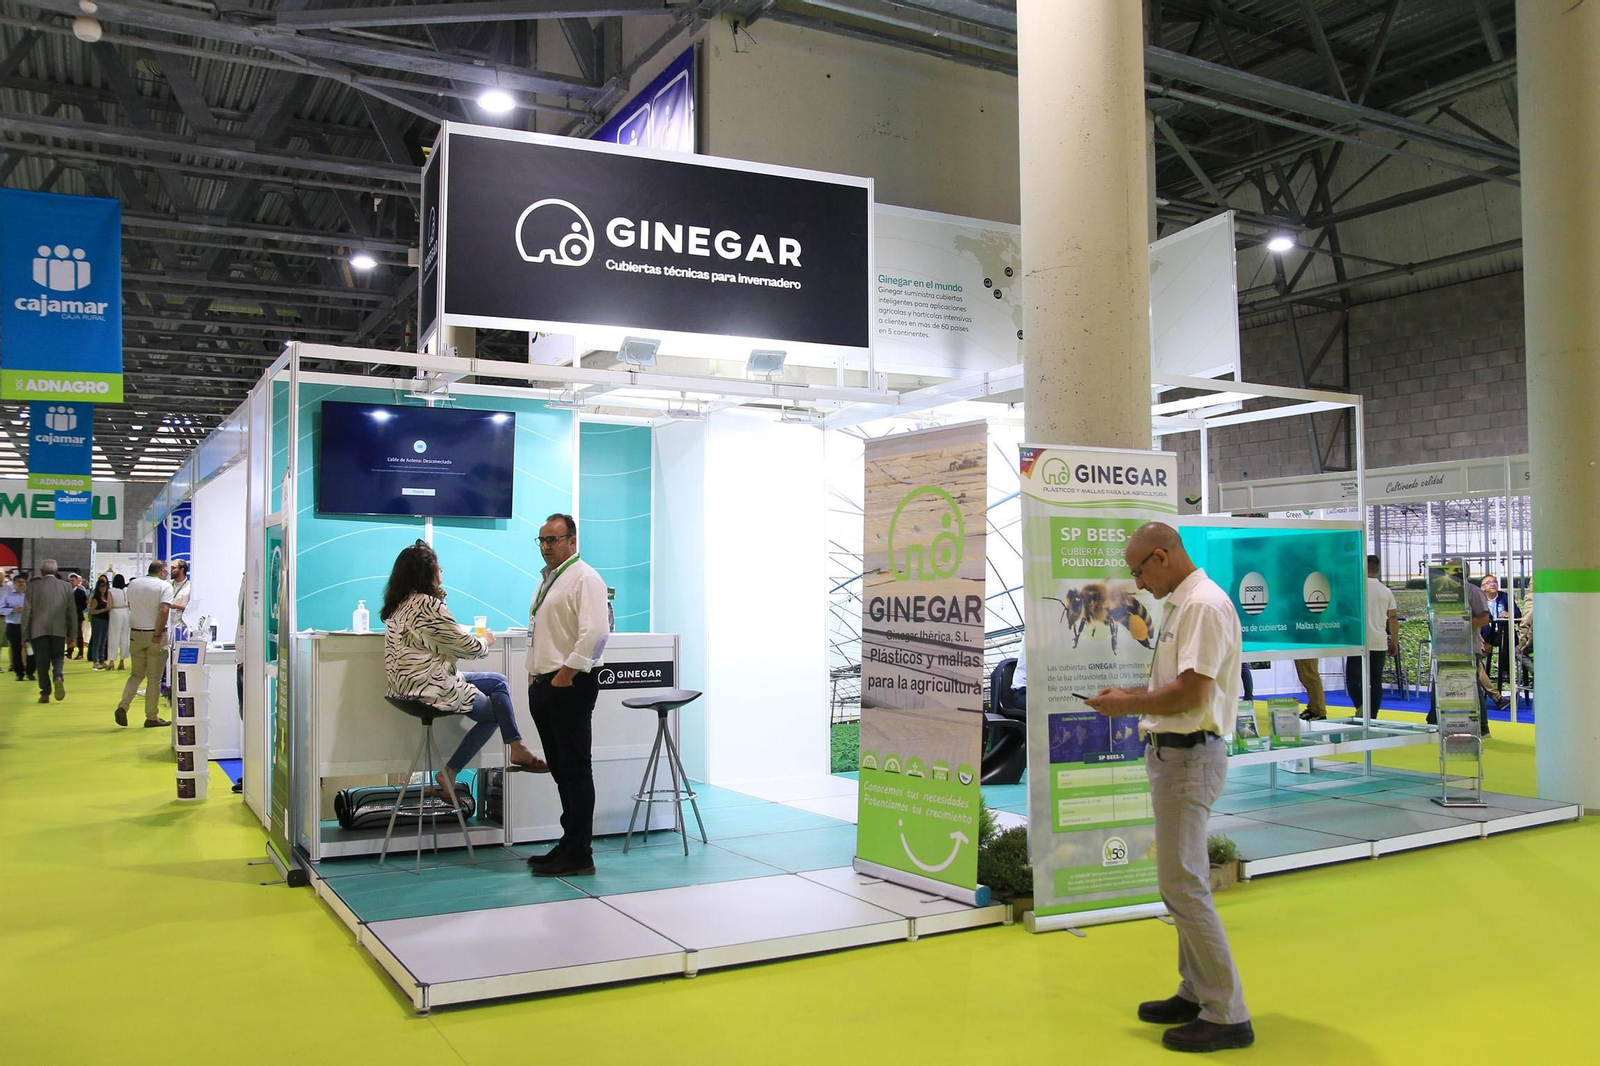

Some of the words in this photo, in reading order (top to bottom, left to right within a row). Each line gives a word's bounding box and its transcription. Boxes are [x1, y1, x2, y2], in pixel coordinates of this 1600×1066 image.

[606, 216, 802, 267] GINEGAR
[606, 259, 662, 276] Cubiertas
[664, 266, 710, 281] técnicas
[711, 272, 736, 284] para
[738, 273, 801, 290] invernadero
[878, 274, 912, 288] Ginegar
[926, 280, 933, 288] el
[934, 284, 963, 292] mundo
[878, 286, 903, 296] Ginegar
[904, 290, 935, 298] suministra
[936, 293, 963, 302] cubiertas
[14, 294, 108, 317] cajamar
[878, 296, 913, 306] inteligentes
[930, 302, 967, 312] aplicaciones
[878, 306, 906, 316] agrícolas
[944, 314, 972, 322] intensivas
[884, 318, 908, 326] clientes
[26, 379, 110, 394] ADNAGRO
[35, 433, 86, 446] cajamar
[39, 478, 85, 487] ADNAGRO
[1075, 464, 1167, 487] GINEGAR
[1386, 479, 1418, 493] Cultivando
[1420, 474, 1444, 487] calidad
[0, 492, 117, 520] MEU
[58, 495, 88, 503] cajamar
[1061, 527, 1081, 541] SP
[1087, 528, 1136, 542] BEES-
[1061, 548, 1103, 556] CUBIERTA
[1062, 558, 1130, 567] POLINIZADO
[869, 595, 982, 623] GINEGAR
[1259, 623, 1287, 631] cubiertas
[1296, 622, 1314, 630] Mallas
[886, 630, 918, 643] Ginegar
[920, 630, 953, 643] Ibérica,
[955, 631, 972, 642] S.L.
[870, 648, 923, 665] Plásticos
[926, 654, 934, 669] y
[938, 652, 980, 668] mallas
[1119, 662, 1145, 670] permiten
[617, 670, 662, 678] GINEGAR
[868, 676, 894, 690] para
[898, 675, 908, 690] la
[910, 677, 982, 695] agricultura
[864, 781, 903, 796] Conocemos
[907, 789, 919, 799] tus
[924, 792, 969, 809] necesidades
[864, 794, 908, 812] Potenciamos
[912, 804, 921, 814] tu
[926, 808, 972, 824] crecimiento
